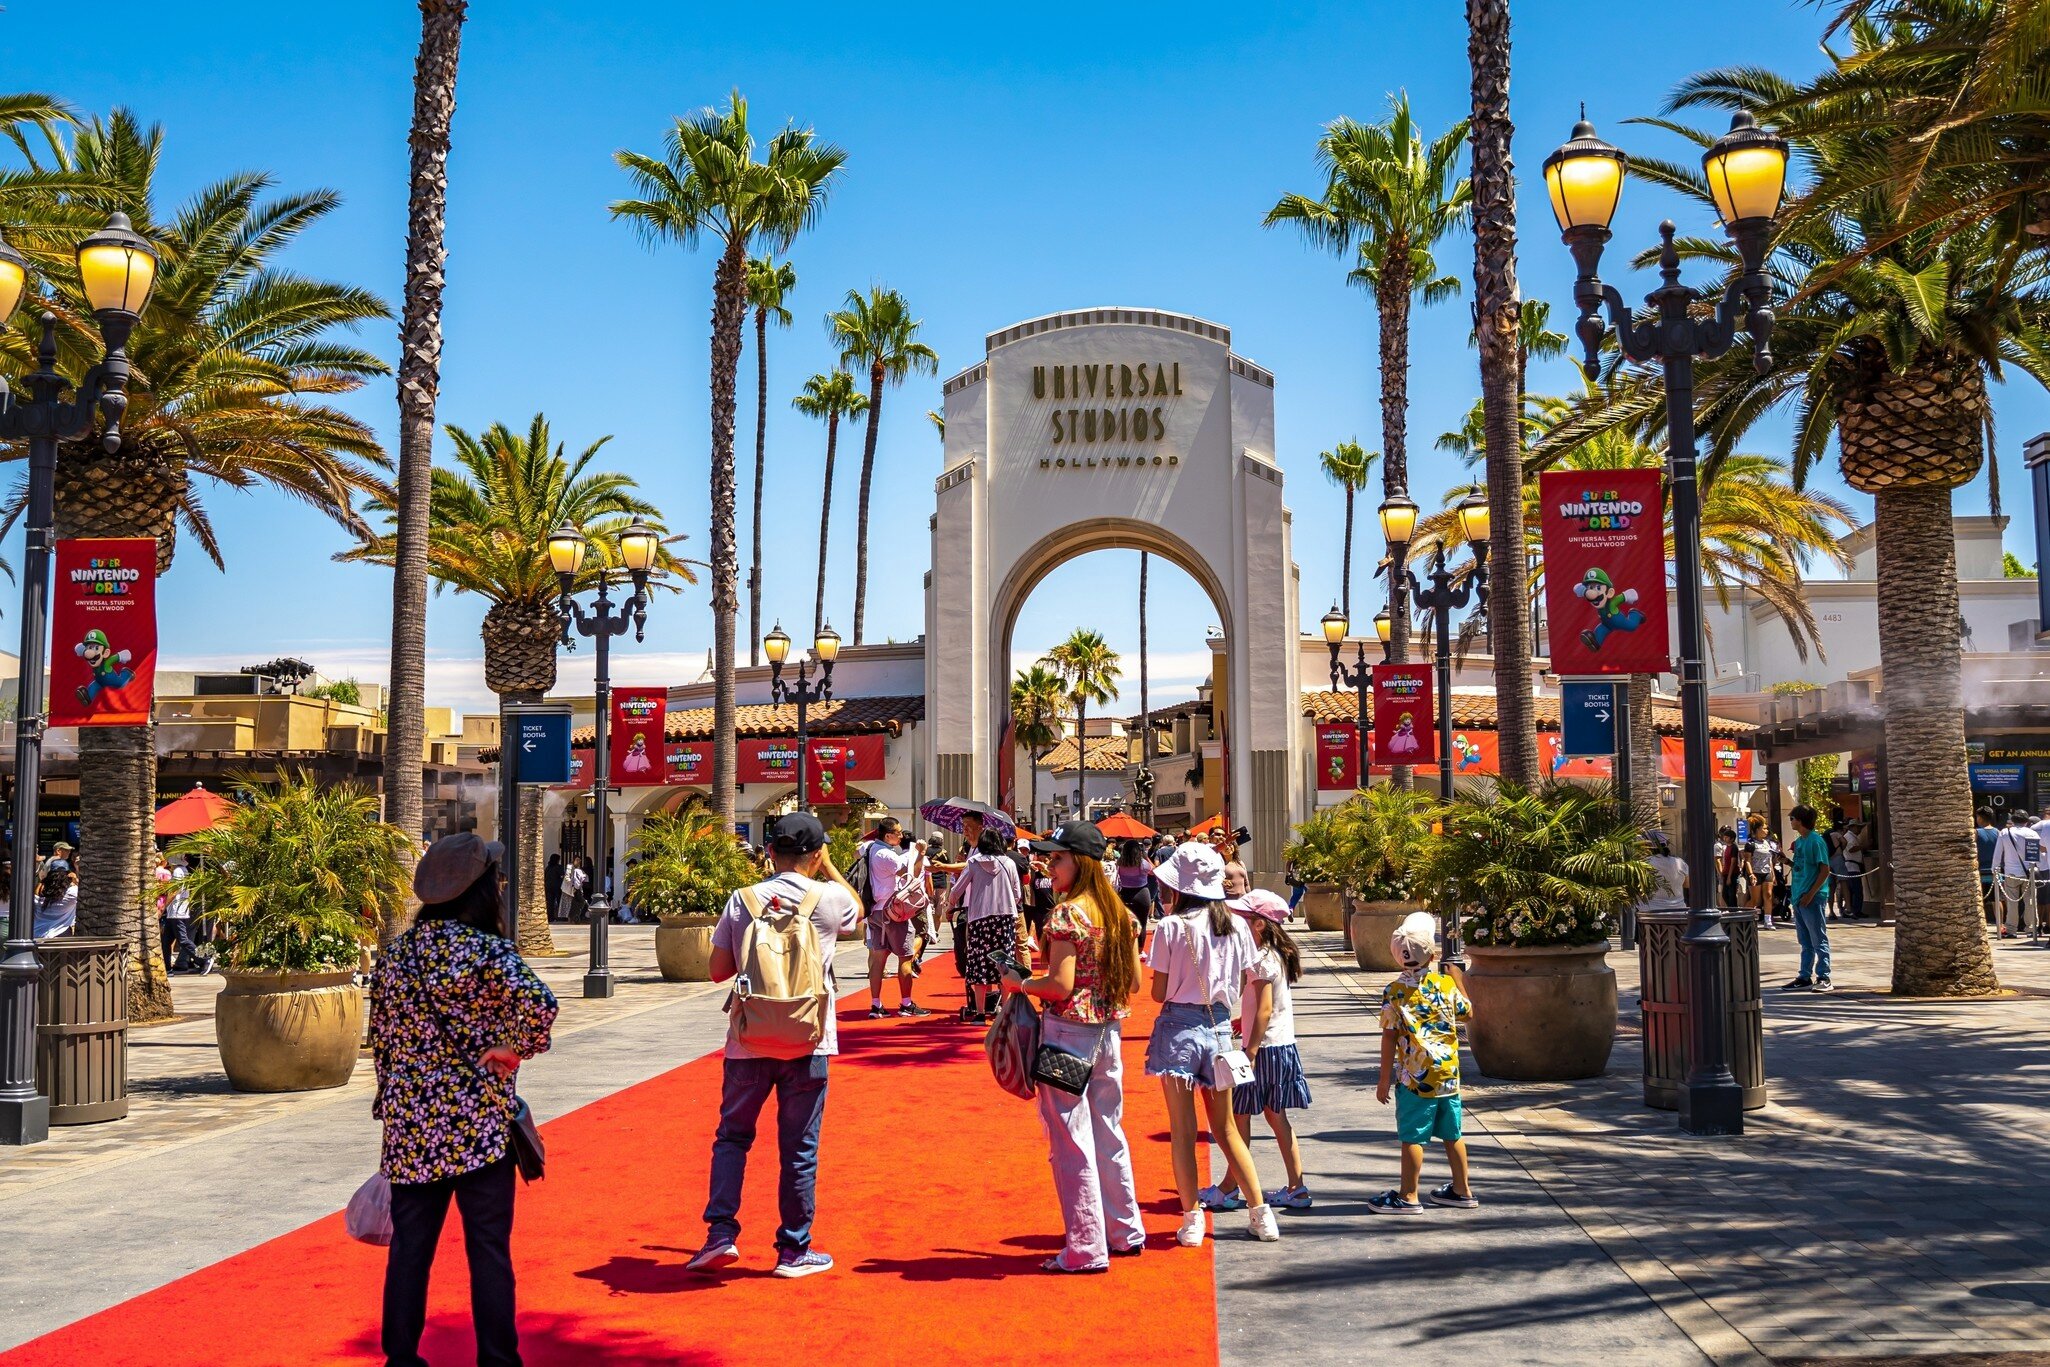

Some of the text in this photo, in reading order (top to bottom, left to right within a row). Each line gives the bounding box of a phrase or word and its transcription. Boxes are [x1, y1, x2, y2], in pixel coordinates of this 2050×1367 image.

[1033, 362, 1183, 399] UNIVERSAL
[1051, 406, 1165, 444] STUDIOS
[1040, 455, 1179, 468] HOLLYWOOD
[1582, 490, 1619, 501] SUER
[1560, 501, 1643, 517] NINTENDO
[90, 558, 121, 568] SUER
[70, 568, 140, 582] NINTENDO
[1822, 614, 1842, 622] 4483
[1382, 679, 1424, 688] NINTENDO
[1391, 686, 1417, 694] ORLD
[620, 701, 658, 709] NINTENDO
[666, 753, 702, 763] NINTENDO
[757, 750, 799, 760] NINTENDO
[1988, 750, 2050, 758] GET AN ANNUA
[675, 762, 697, 770] ORLD
[767, 759, 792, 768] ORLD
[1987, 795, 2005, 807] 10
[1402, 949, 1411, 960] 3
